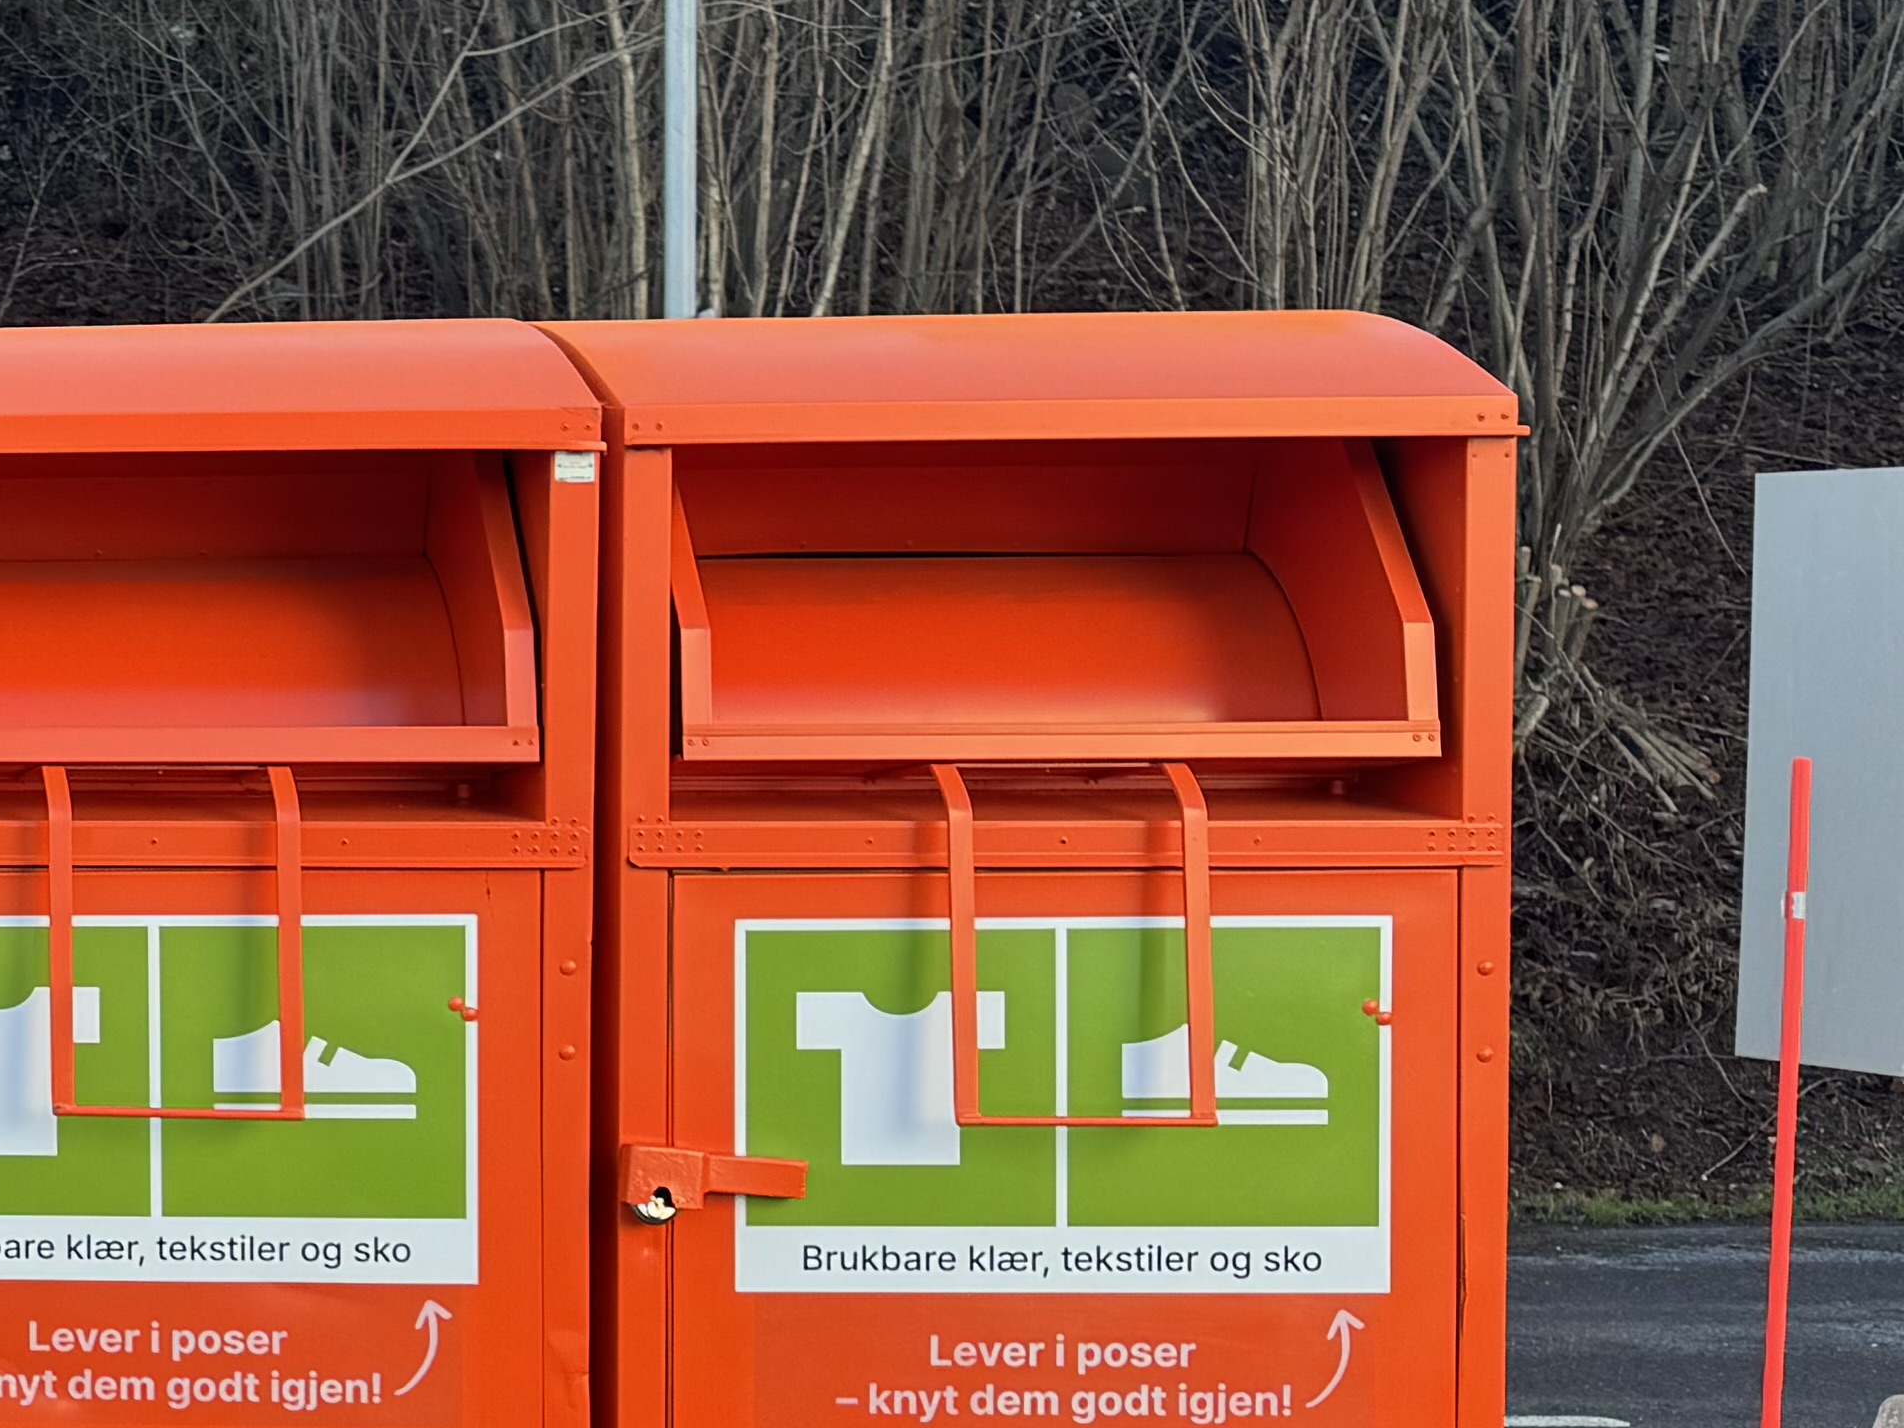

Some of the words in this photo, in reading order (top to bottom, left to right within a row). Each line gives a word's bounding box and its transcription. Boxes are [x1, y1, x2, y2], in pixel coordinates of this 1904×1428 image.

[67, 1233, 145, 1267] klær,
[156, 1234, 291, 1262] tekstiler
[301, 1242, 342, 1270] og
[354, 1236, 411, 1263] sko
[803, 1244, 957, 1272] Brukbare
[969, 1245, 1049, 1278] klær,
[1061, 1244, 1199, 1272] tekstiler
[1210, 1251, 1251, 1279] og
[1264, 1245, 1322, 1272] sko
[29, 1320, 141, 1354] Lever
[151, 1320, 160, 1354] i
[171, 1329, 288, 1362] poser
[930, 1334, 1046, 1368] Lever
[1055, 1333, 1065, 1367] i
[1077, 1342, 1197, 1375] poser
[67, 1368, 156, 1401] dem
[166, 1371, 260, 1410] godt
[271, 1370, 381, 1411] igjen!
[868, 1382, 959, 1423] knyt
[970, 1383, 1060, 1416] dem
[1071, 1384, 1167, 1424] godt
[1178, 1382, 1292, 1425] igjen!
